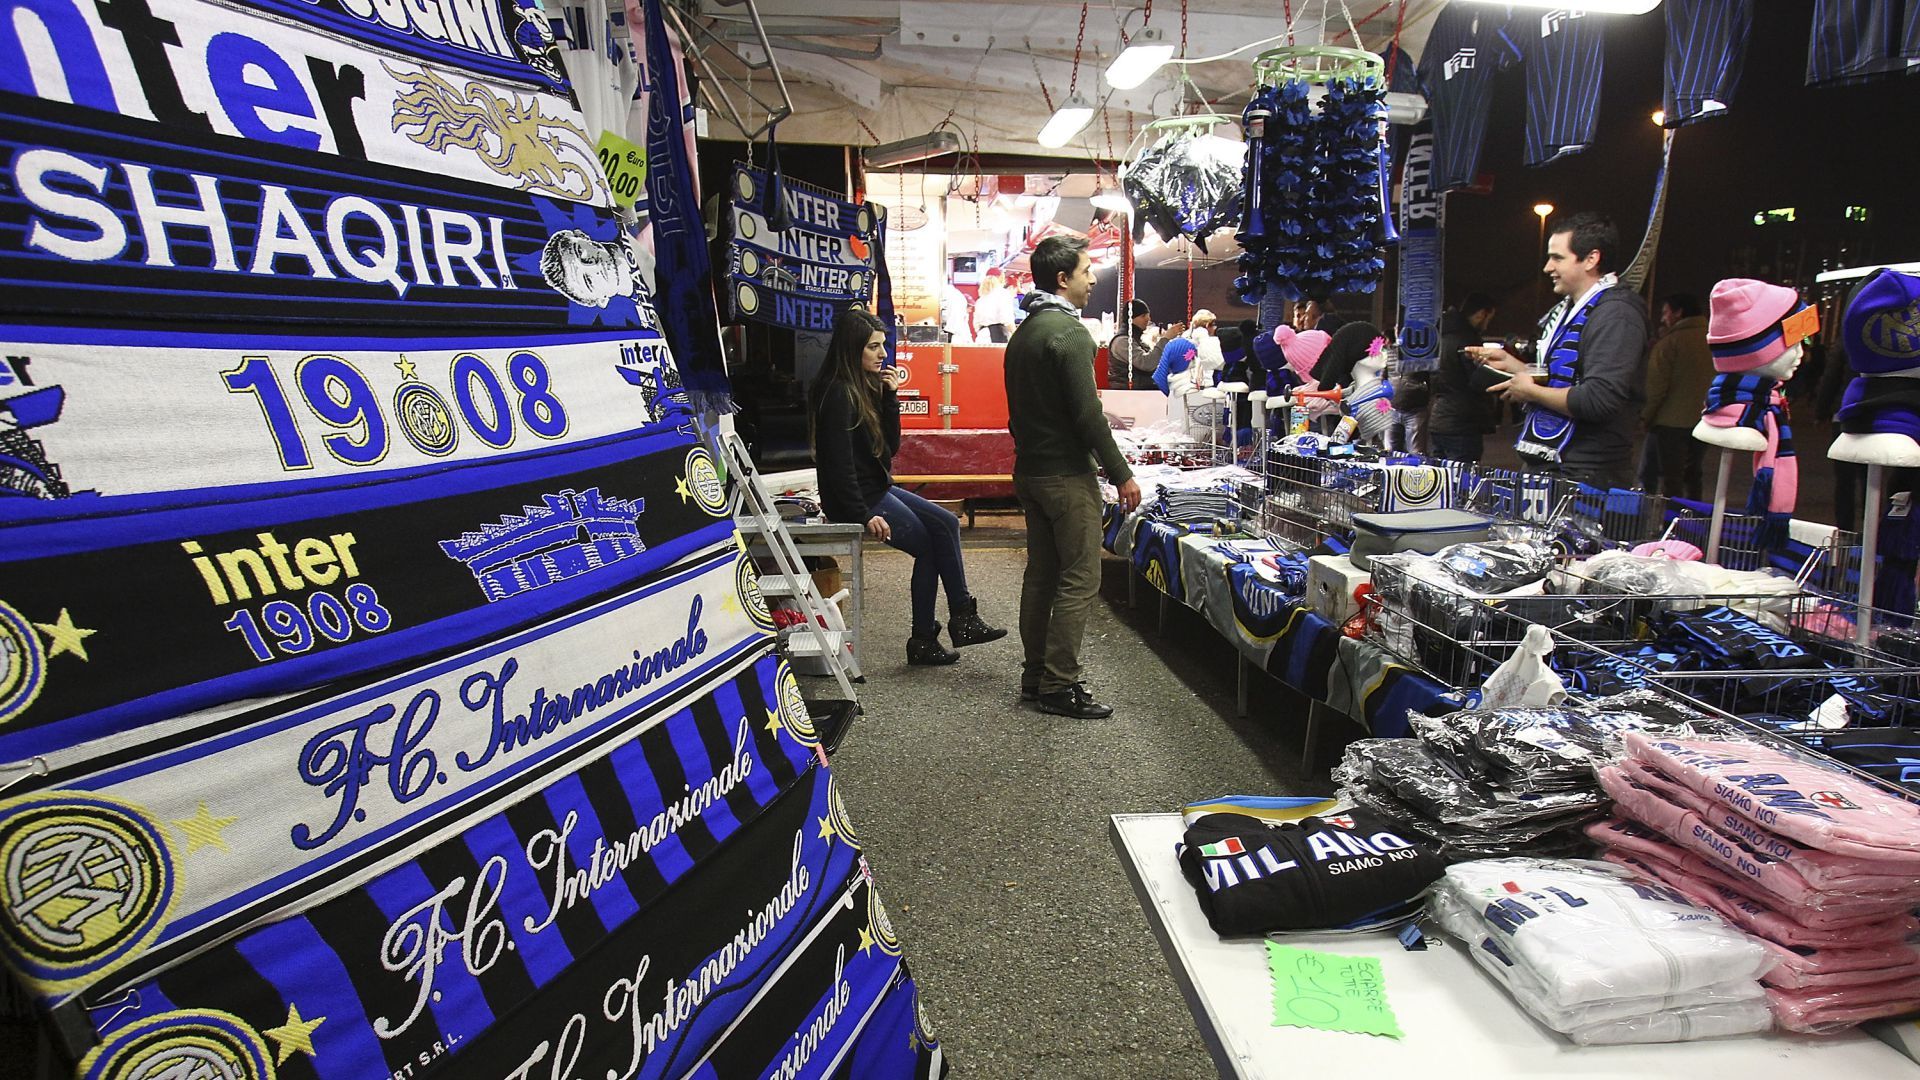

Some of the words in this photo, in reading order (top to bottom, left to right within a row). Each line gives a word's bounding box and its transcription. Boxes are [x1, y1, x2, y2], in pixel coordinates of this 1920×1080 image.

[15, 148, 518, 297] SHAQIRI
[782, 186, 841, 230] NTER
[778, 228, 845, 264] INTER
[801, 263, 849, 289] INTER
[775, 294, 834, 329] INTER
[619, 342, 659, 366] inter
[182, 531, 361, 606] inter
[226, 583, 393, 662] 1908
[460, 595, 707, 763] Internazionale
[527, 718, 754, 931] Internazionale
[1714, 782, 1752, 812] SIAMO
[1754, 806, 1777, 826] NOI
[1692, 825, 1733, 859] SIAMO
[1737, 856, 1761, 878] NOI
[1723, 815, 1764, 846] SIAMO
[1766, 841, 1793, 860] NOI
[1328, 856, 1383, 875] SIAMO
[1388, 849, 1418, 863] NOI
[418, 1033, 464, 1067] S.R.L.
